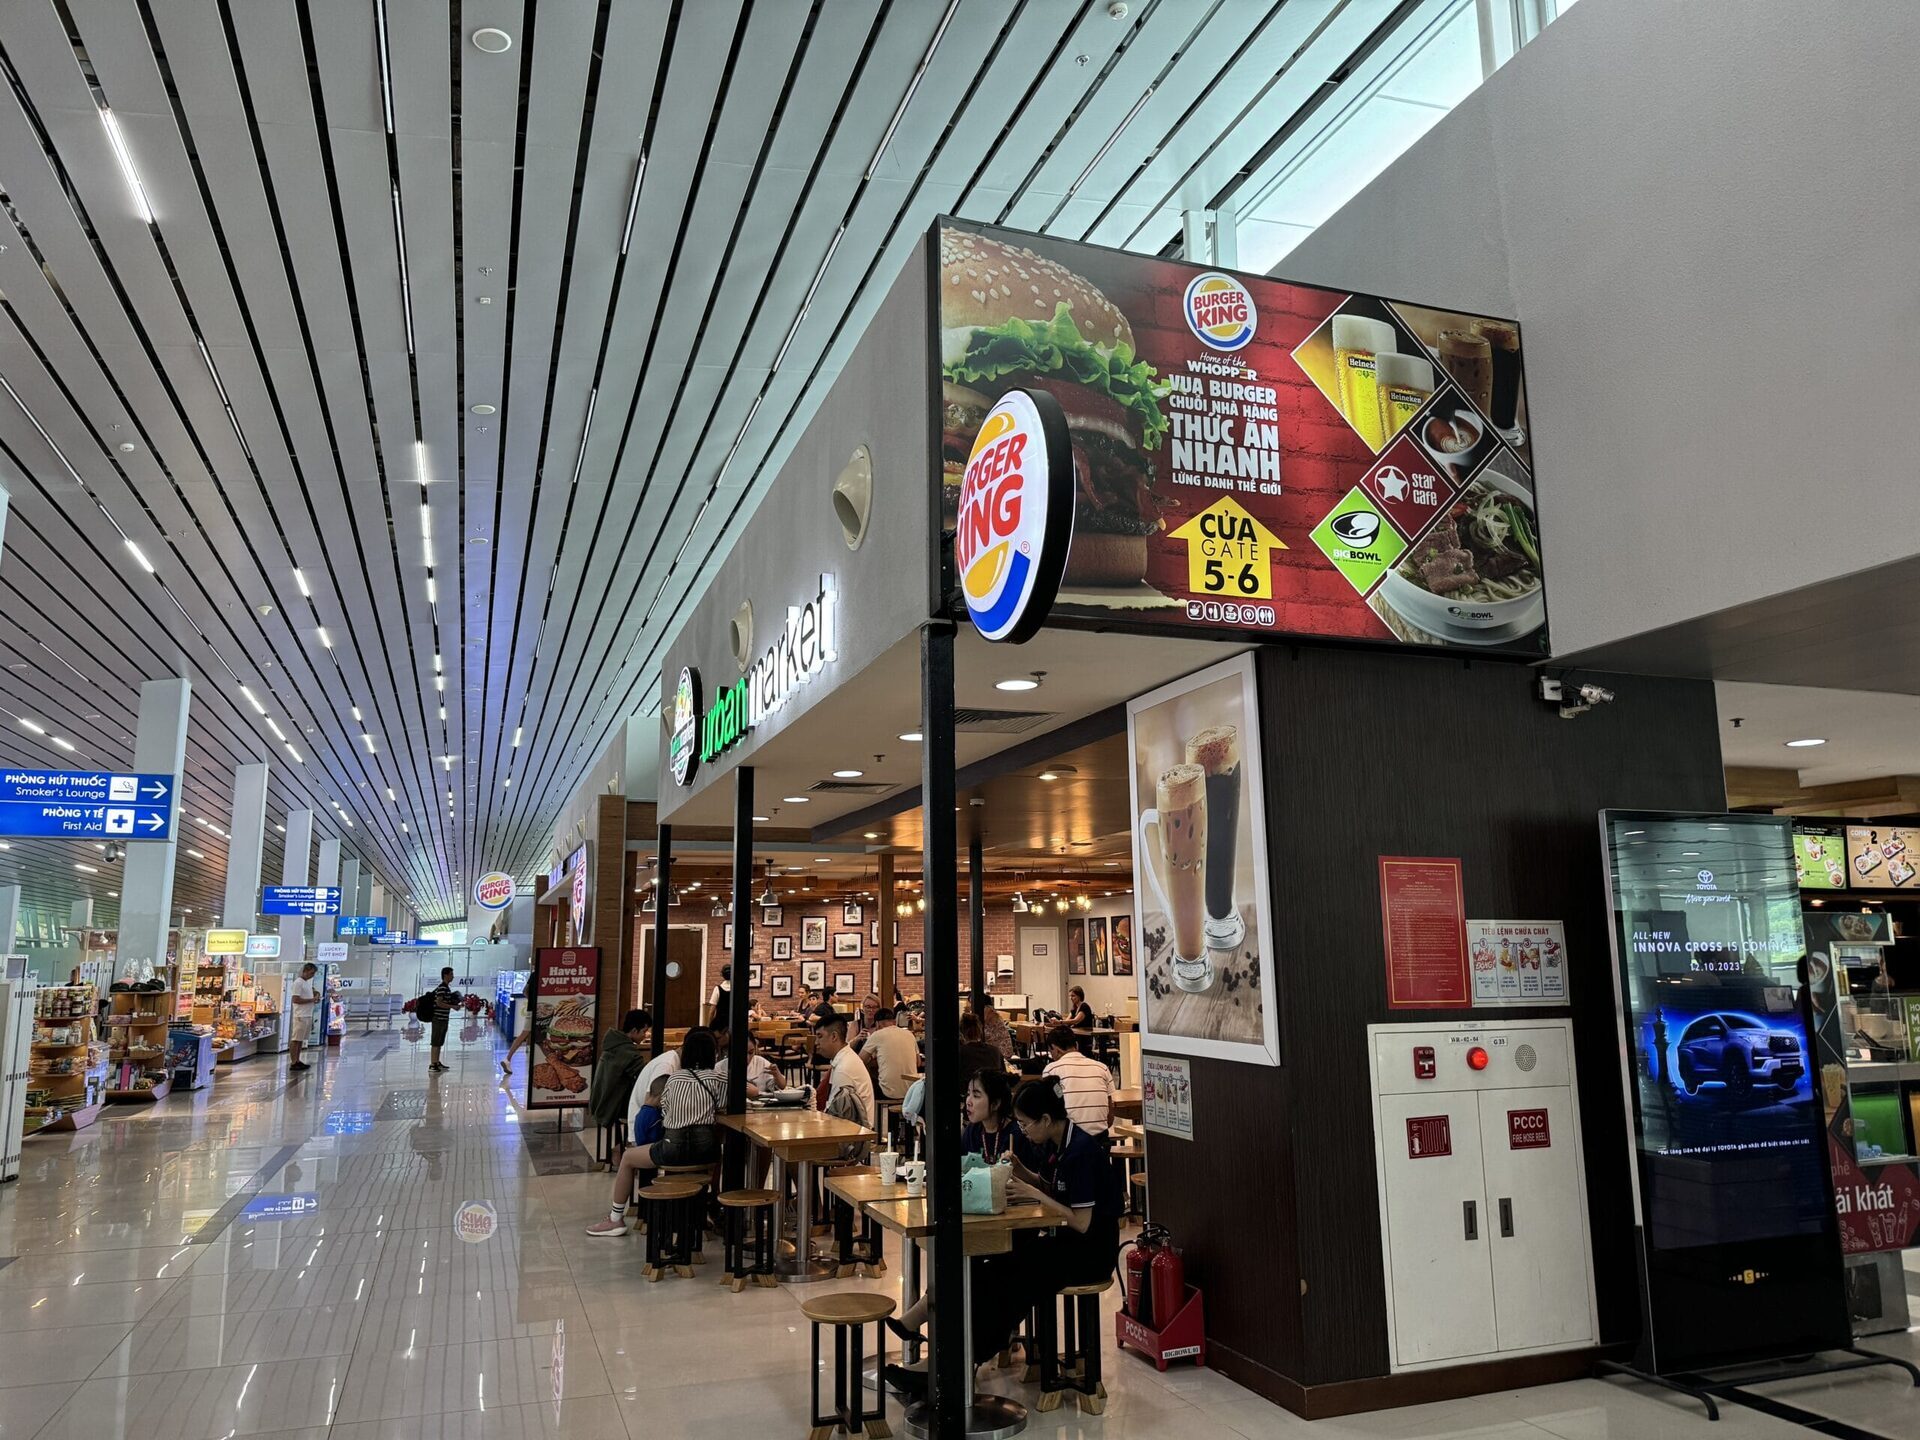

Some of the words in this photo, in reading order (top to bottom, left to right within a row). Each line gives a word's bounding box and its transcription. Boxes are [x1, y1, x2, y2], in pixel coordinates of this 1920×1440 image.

[1194, 292, 1244, 310] BURGER
[1197, 304, 1248, 330] KING
[1200, 352, 1221, 362] Home
[1222, 354, 1232, 366] of
[1233, 356, 1246, 367] the
[1349, 358, 1376, 370] Heinek
[1210, 380, 1277, 406] BURGER
[1212, 400, 1239, 416] NHÀ
[1242, 404, 1278, 422] HÀNG
[1170, 412, 1234, 445] THỨC
[1244, 418, 1279, 450] ĂN
[1172, 438, 1280, 481] NHANH
[960, 432, 1028, 514] URGER
[1172, 472, 1200, 486] LỪNG
[1204, 476, 1234, 490] DANH
[1237, 478, 1256, 492] THẾ
[1260, 481, 1282, 496] GIỚI
[1200, 510, 1258, 542] CỬA
[1202, 539, 1258, 560] GATE
[1204, 560, 1259, 594] 5-6
[5, 772, 46, 784] PHÒNG
[48, 773, 67, 786] HÚT
[70, 774, 107, 786] THUỐC
[16, 786, 64, 797] Smoker's
[66, 788, 106, 800] Lounge
[42, 806, 82, 818] PHÒNG
[84, 809, 92, 818] Y
[93, 806, 106, 819] TẾ
[63, 822, 82, 830] First
[84, 822, 102, 831] Aid
[1870, 830, 1878, 844] 2
[480, 880, 510, 892] BURGER
[480, 886, 511, 900] KING
[1633, 931, 1670, 939] ALL-NEW
[1634, 942, 1681, 952] INNOVA
[1685, 942, 1722, 951] CROSS
[1728, 941, 1738, 951] IS
[1743, 941, 1788, 951] COMING
[549, 966, 577, 976] Have
[578, 965, 587, 975] it
[459, 977, 474, 986] ACV
[541, 977, 570, 987] your
[571, 977, 594, 986] way
[1514, 1116, 1543, 1129] PCCC
[1513, 1134, 1522, 1143] FIRE
[1836, 1187, 1851, 1214] ải
[1855, 1183, 1895, 1212] khát
[1126, 1320, 1142, 1341] PCCC
